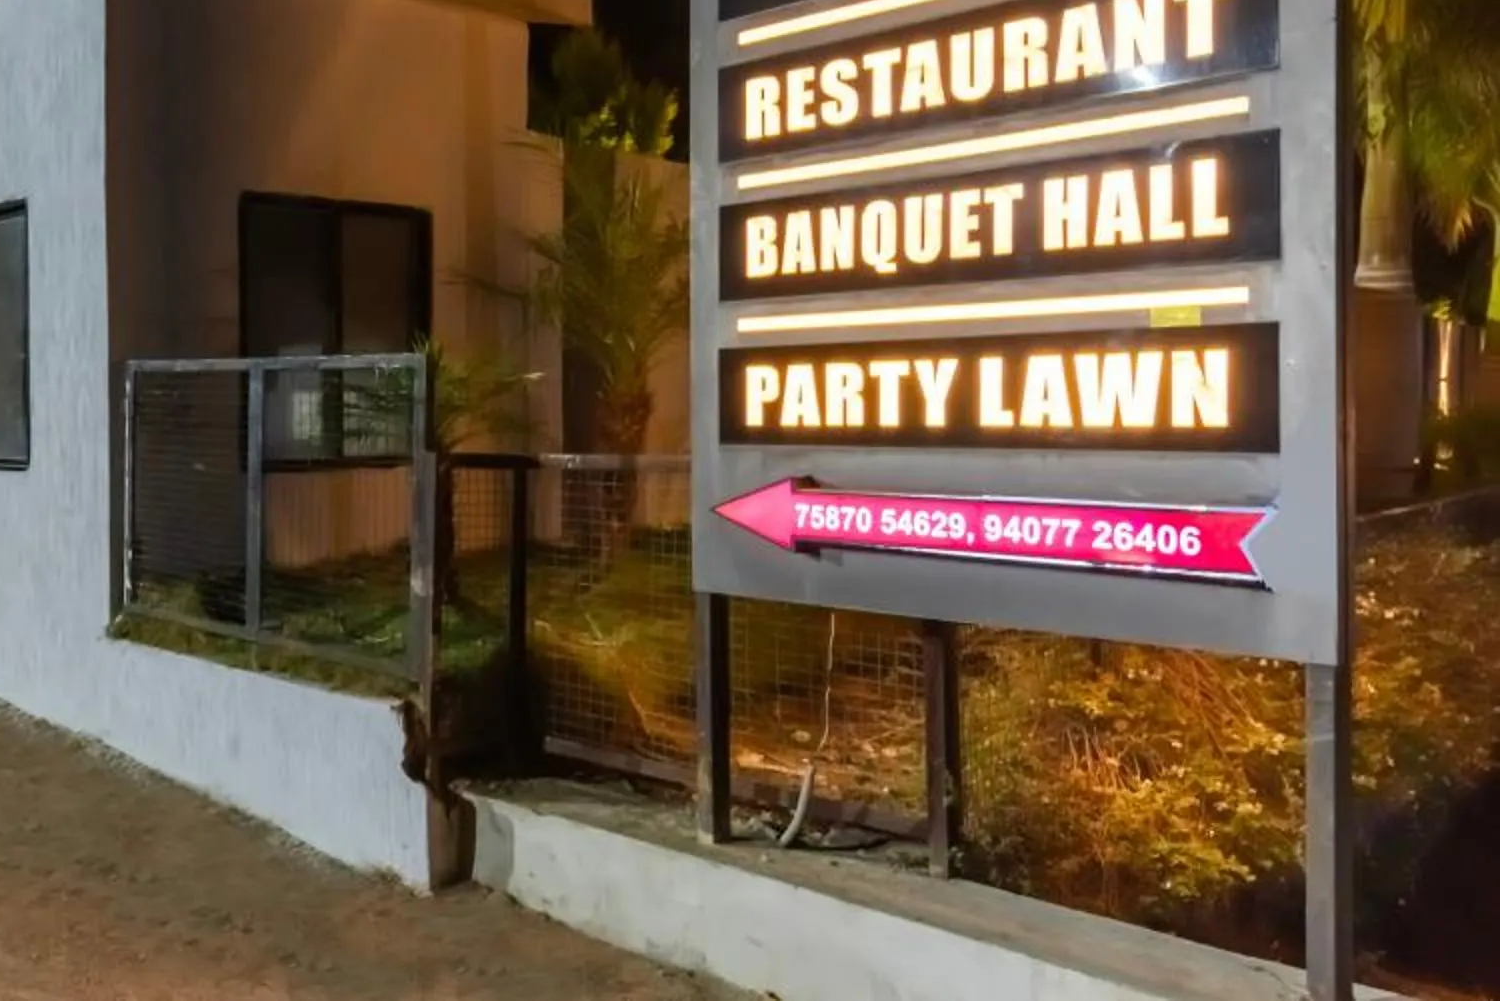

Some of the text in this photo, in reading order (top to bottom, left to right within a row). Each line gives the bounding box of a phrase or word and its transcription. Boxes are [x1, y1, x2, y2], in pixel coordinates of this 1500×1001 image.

[743, 157, 1230, 279] BANQUET HALL
[743, 349, 1230, 429] PARTY LAWN
[794, 503, 1202, 557] 75870 54629, 94077 26406
